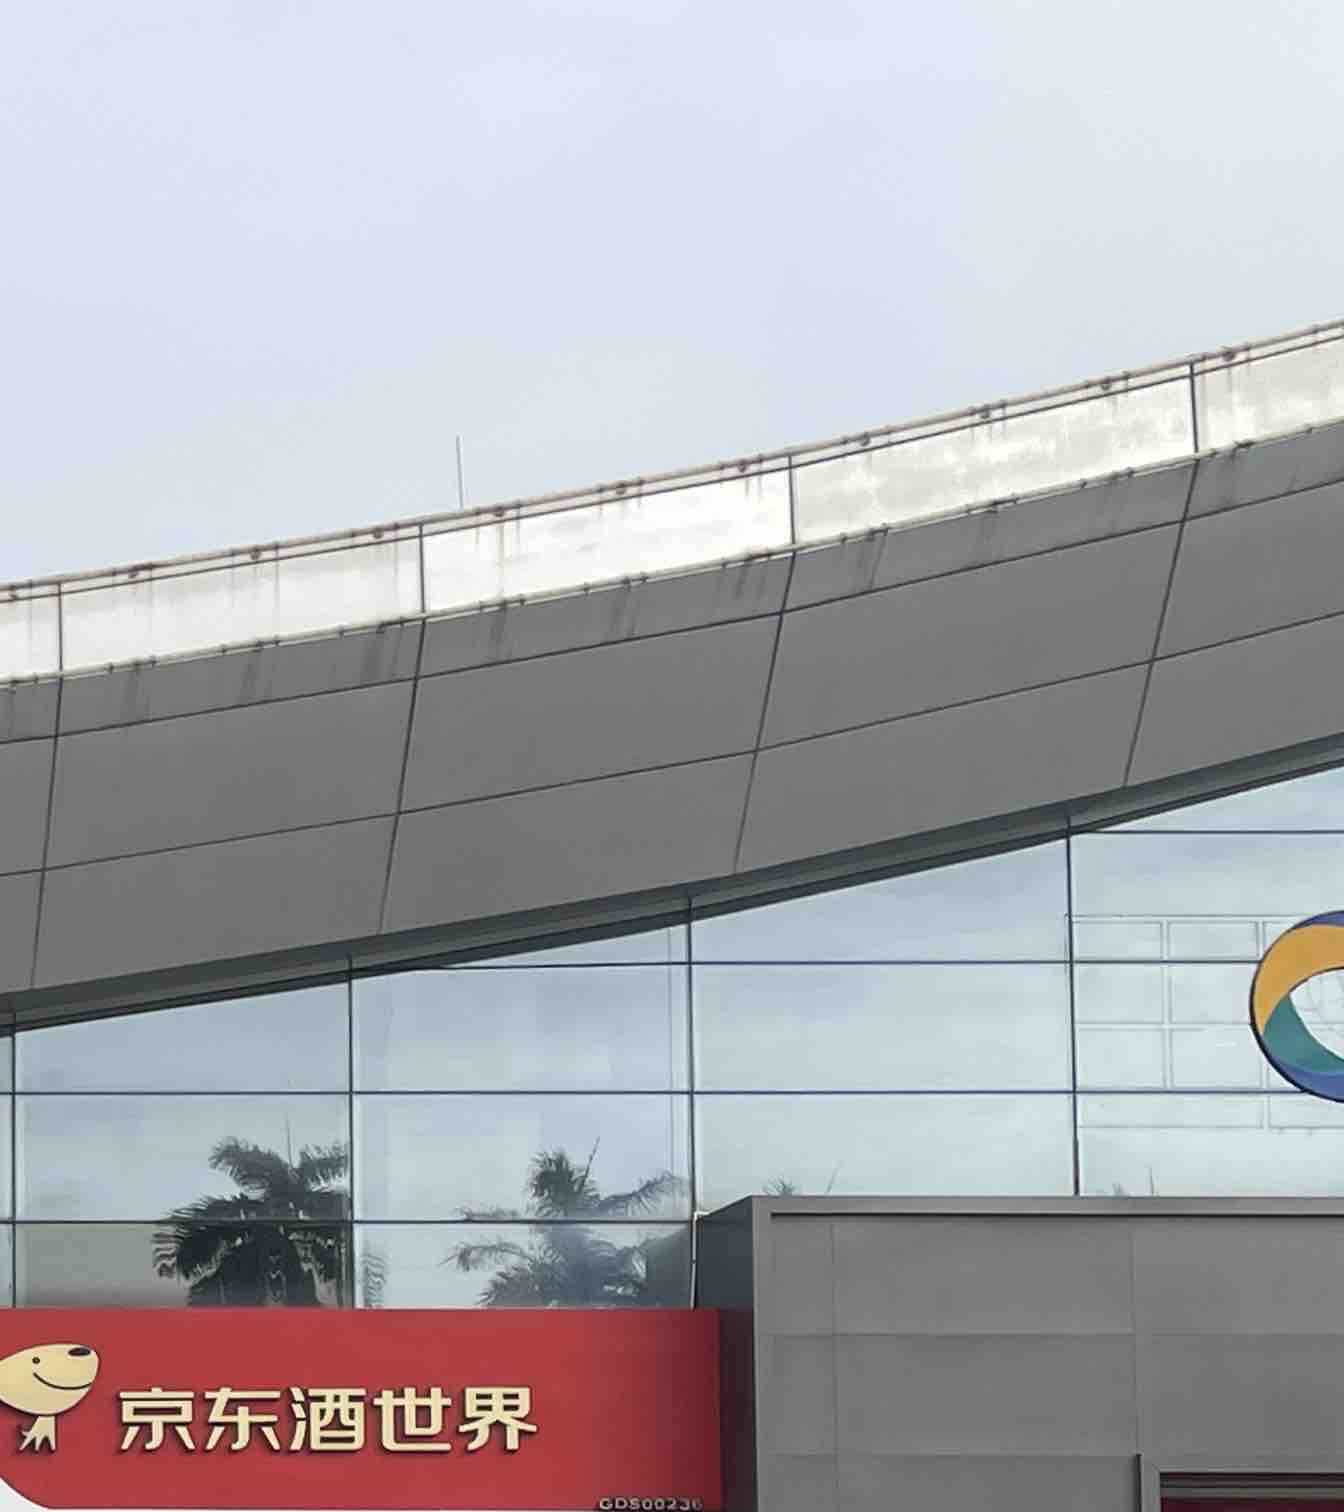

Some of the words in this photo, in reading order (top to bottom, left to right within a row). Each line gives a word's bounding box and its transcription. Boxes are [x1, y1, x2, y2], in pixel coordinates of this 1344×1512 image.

[118, 1386, 539, 1452] 京东酒世界
